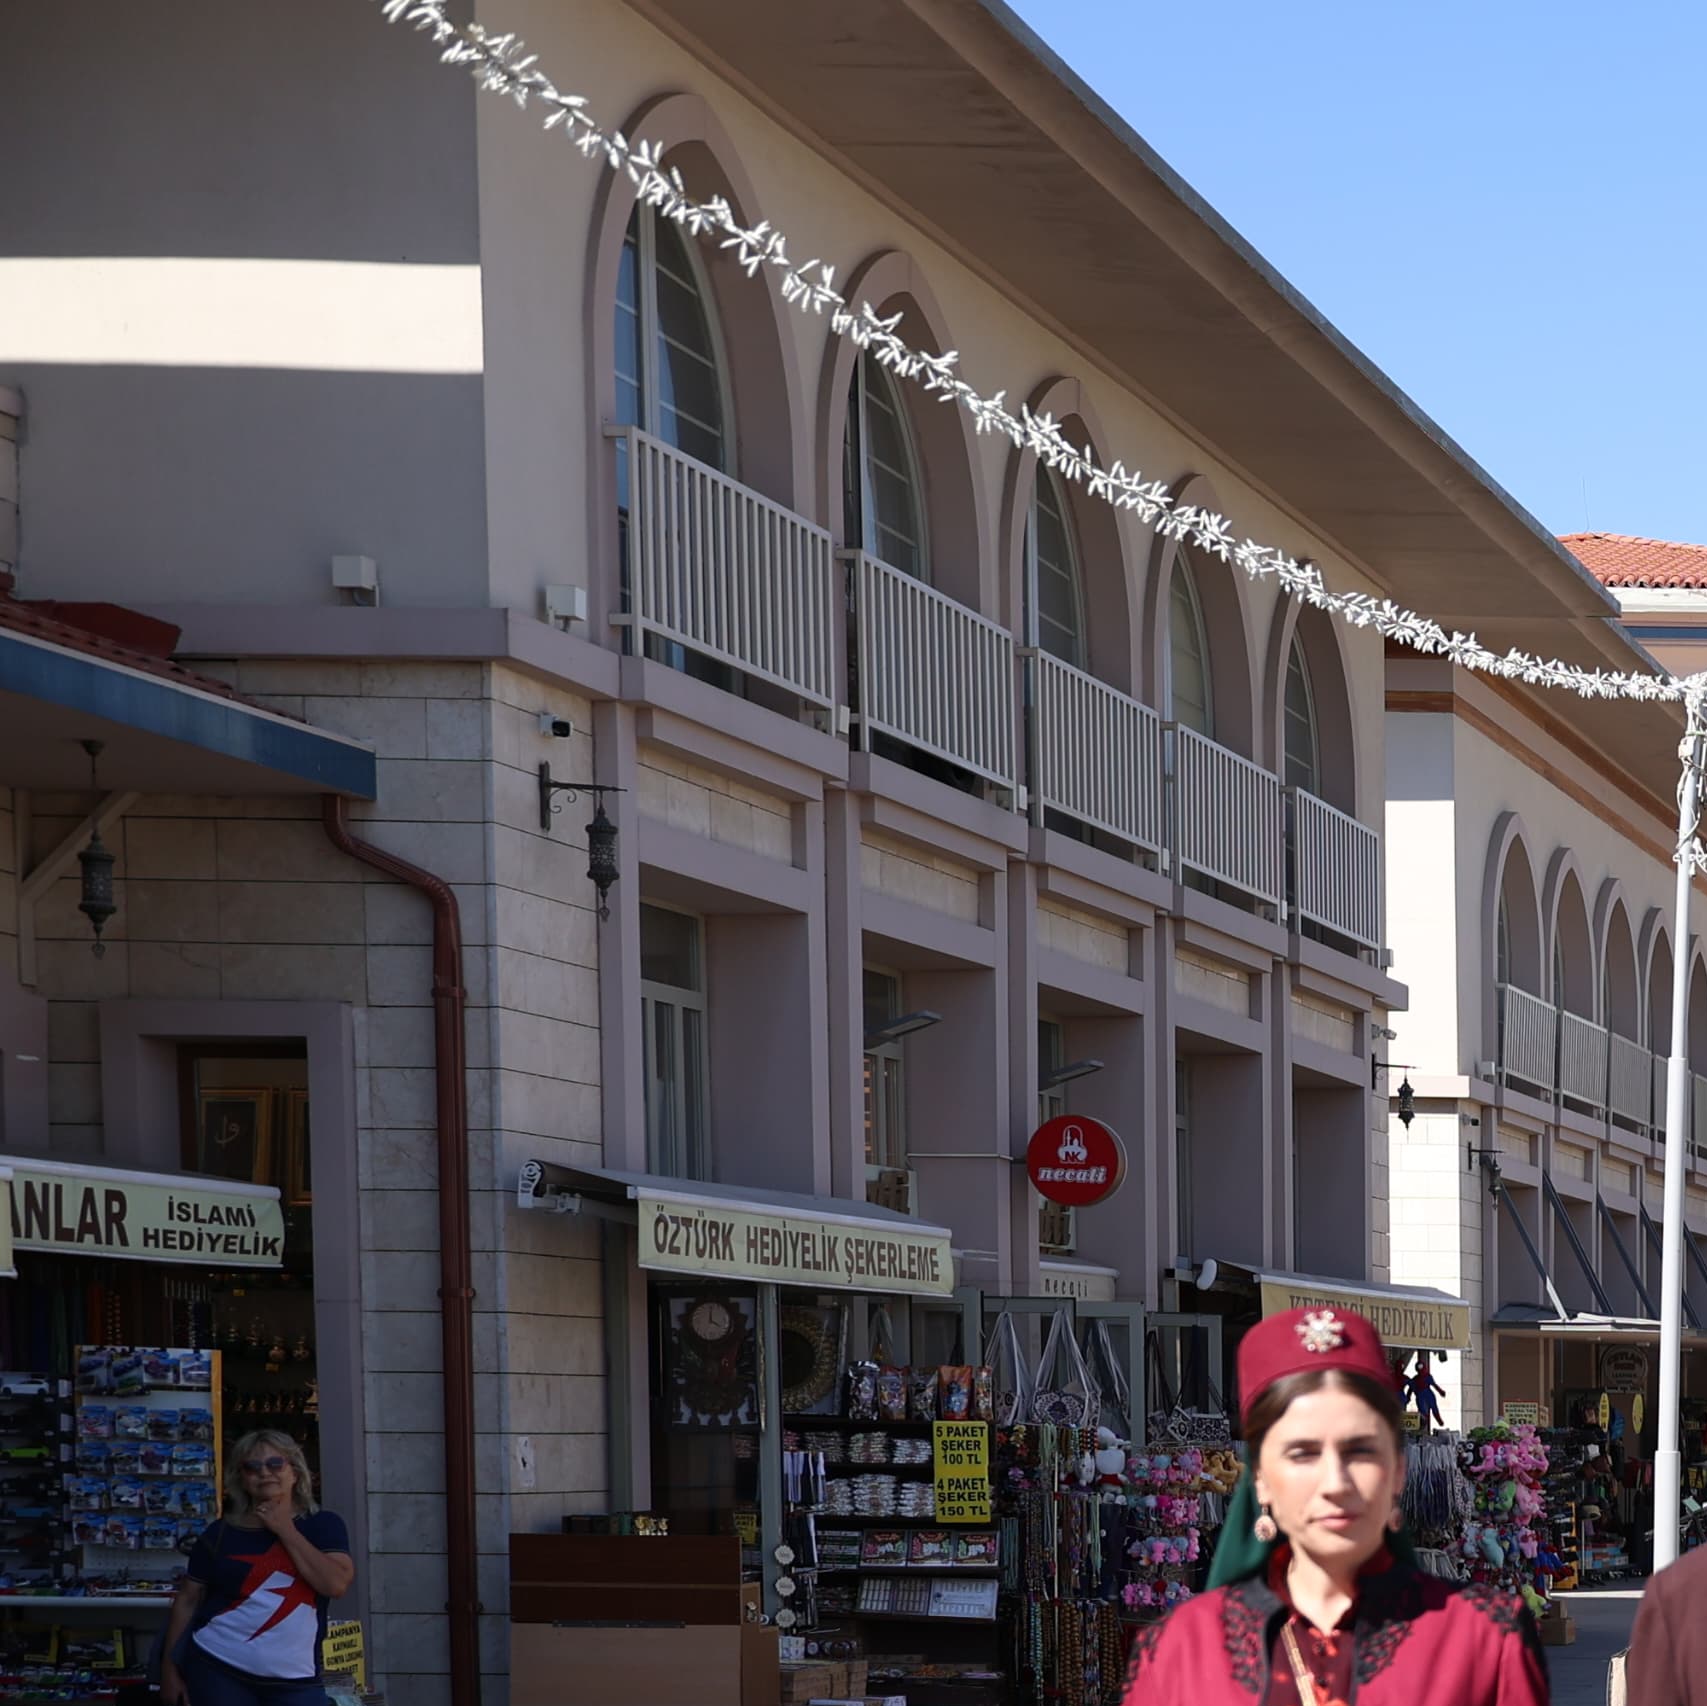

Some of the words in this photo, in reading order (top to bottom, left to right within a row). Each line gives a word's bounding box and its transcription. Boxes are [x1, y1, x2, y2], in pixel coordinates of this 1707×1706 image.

[1065, 1151, 1081, 1162] NK
[1038, 1167, 1107, 1184] necati
[168, 1196, 256, 1228] İSLAMİ
[143, 1226, 280, 1256] HEDİYELİK
[654, 1204, 735, 1262] ÖZTÜRK
[746, 1221, 840, 1273] HEDİYELİK
[844, 1236, 940, 1283] ŞEKERLEME
[1044, 1278, 1089, 1298] necati
[1369, 1302, 1454, 1340] HEDİYELİK
[936, 1426, 943, 1437] 5
[947, 1426, 986, 1437] PAKET
[941, 1440, 981, 1453] ŞEKER
[942, 1454, 963, 1464] 100
[967, 1454, 981, 1464] TL
[937, 1479, 944, 1490] 4
[948, 1478, 986, 1490] PAKET
[938, 1491, 987, 1505] ŞEKER
[939, 1506, 965, 1516] 150
[968, 1506, 988, 1516] TL
[329, 1624, 360, 1639] AMPANYA
